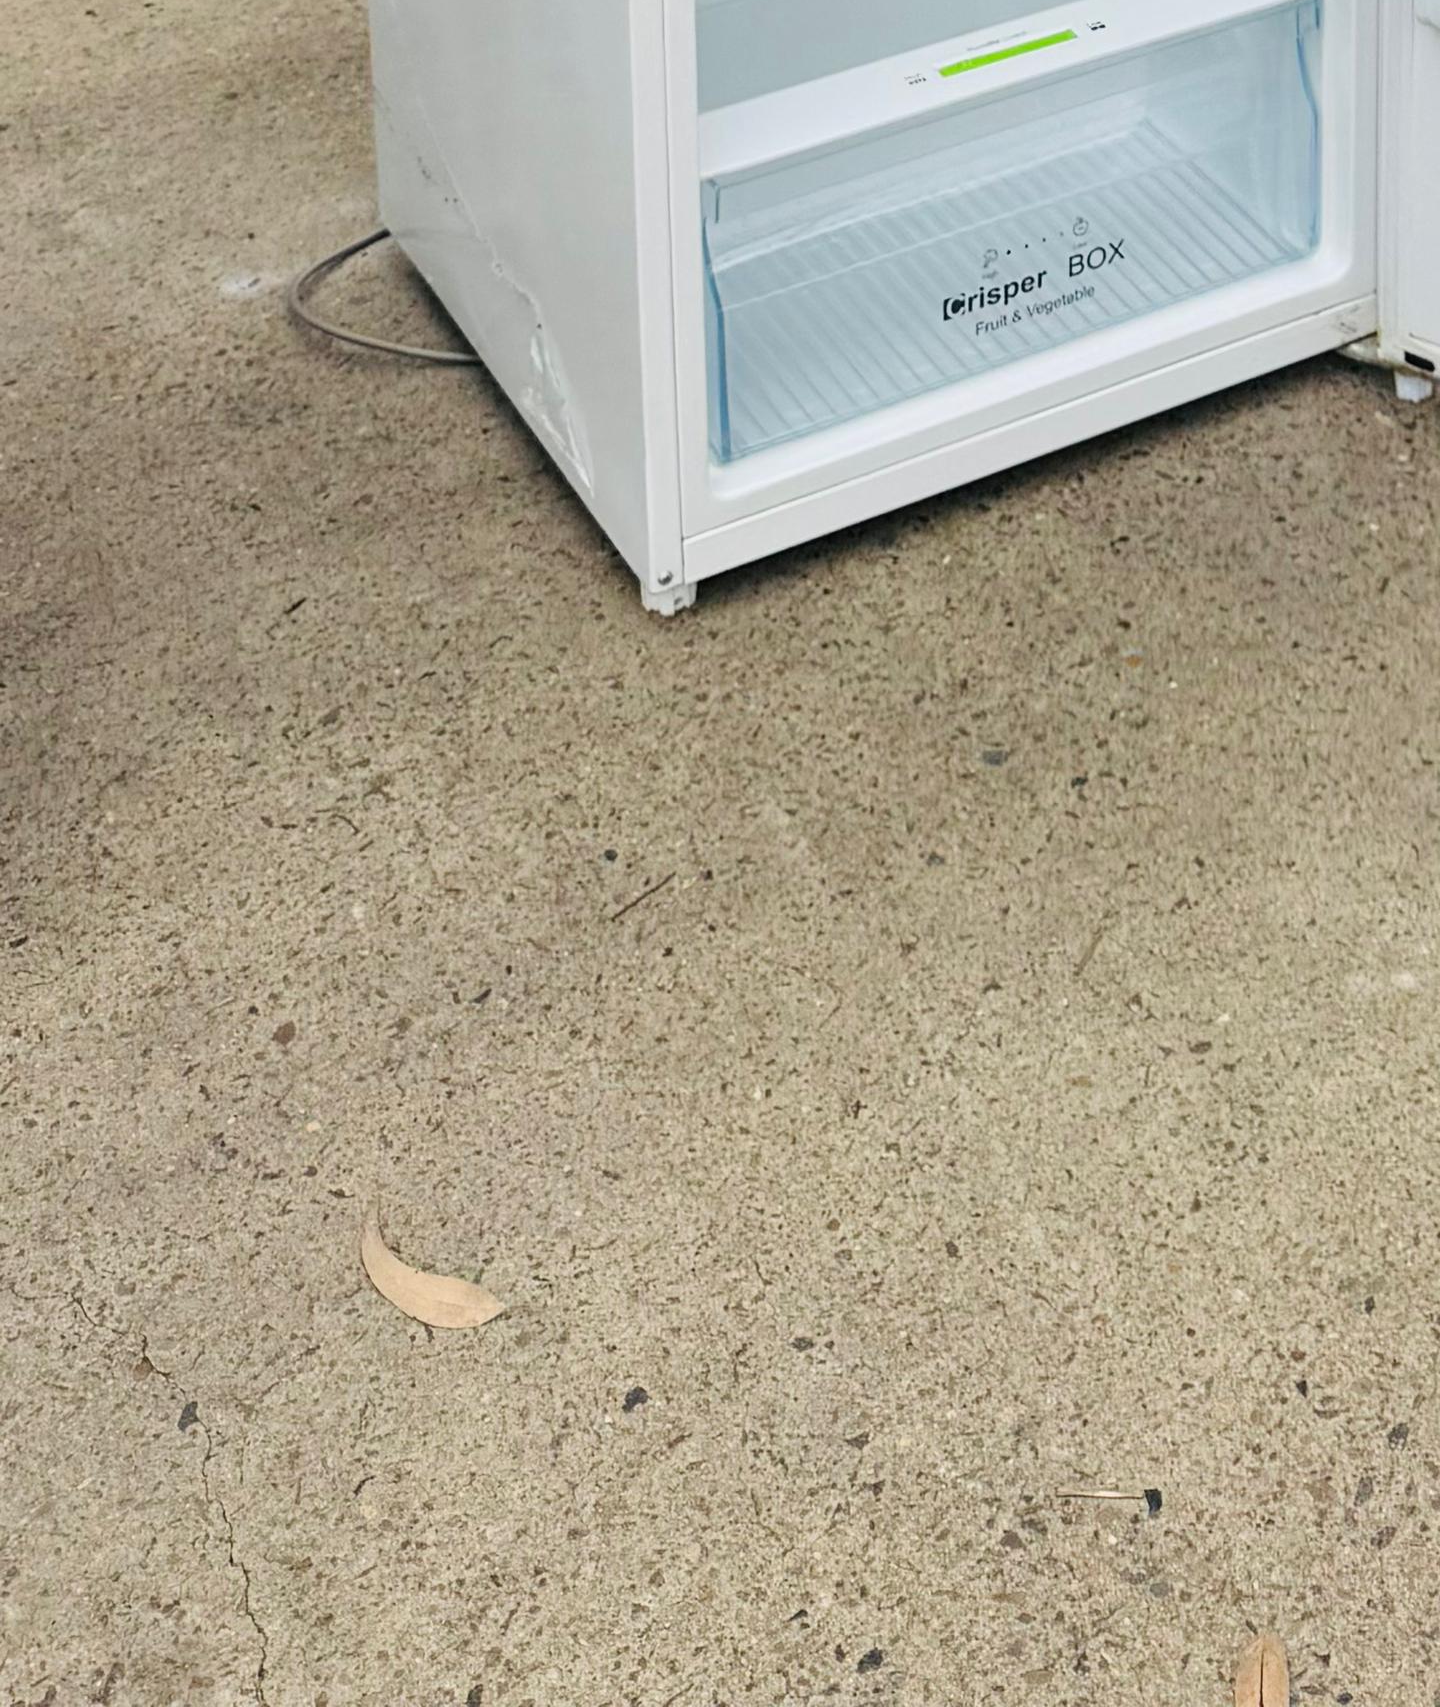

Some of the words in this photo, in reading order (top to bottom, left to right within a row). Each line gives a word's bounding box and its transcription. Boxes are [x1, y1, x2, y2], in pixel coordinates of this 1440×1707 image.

[943, 270, 1047, 321] Crisper
[1068, 238, 1125, 277] BOX
[975, 314, 1007, 336] Fruit
[1012, 310, 1022, 324] &
[1026, 285, 1096, 318] Vegetable
